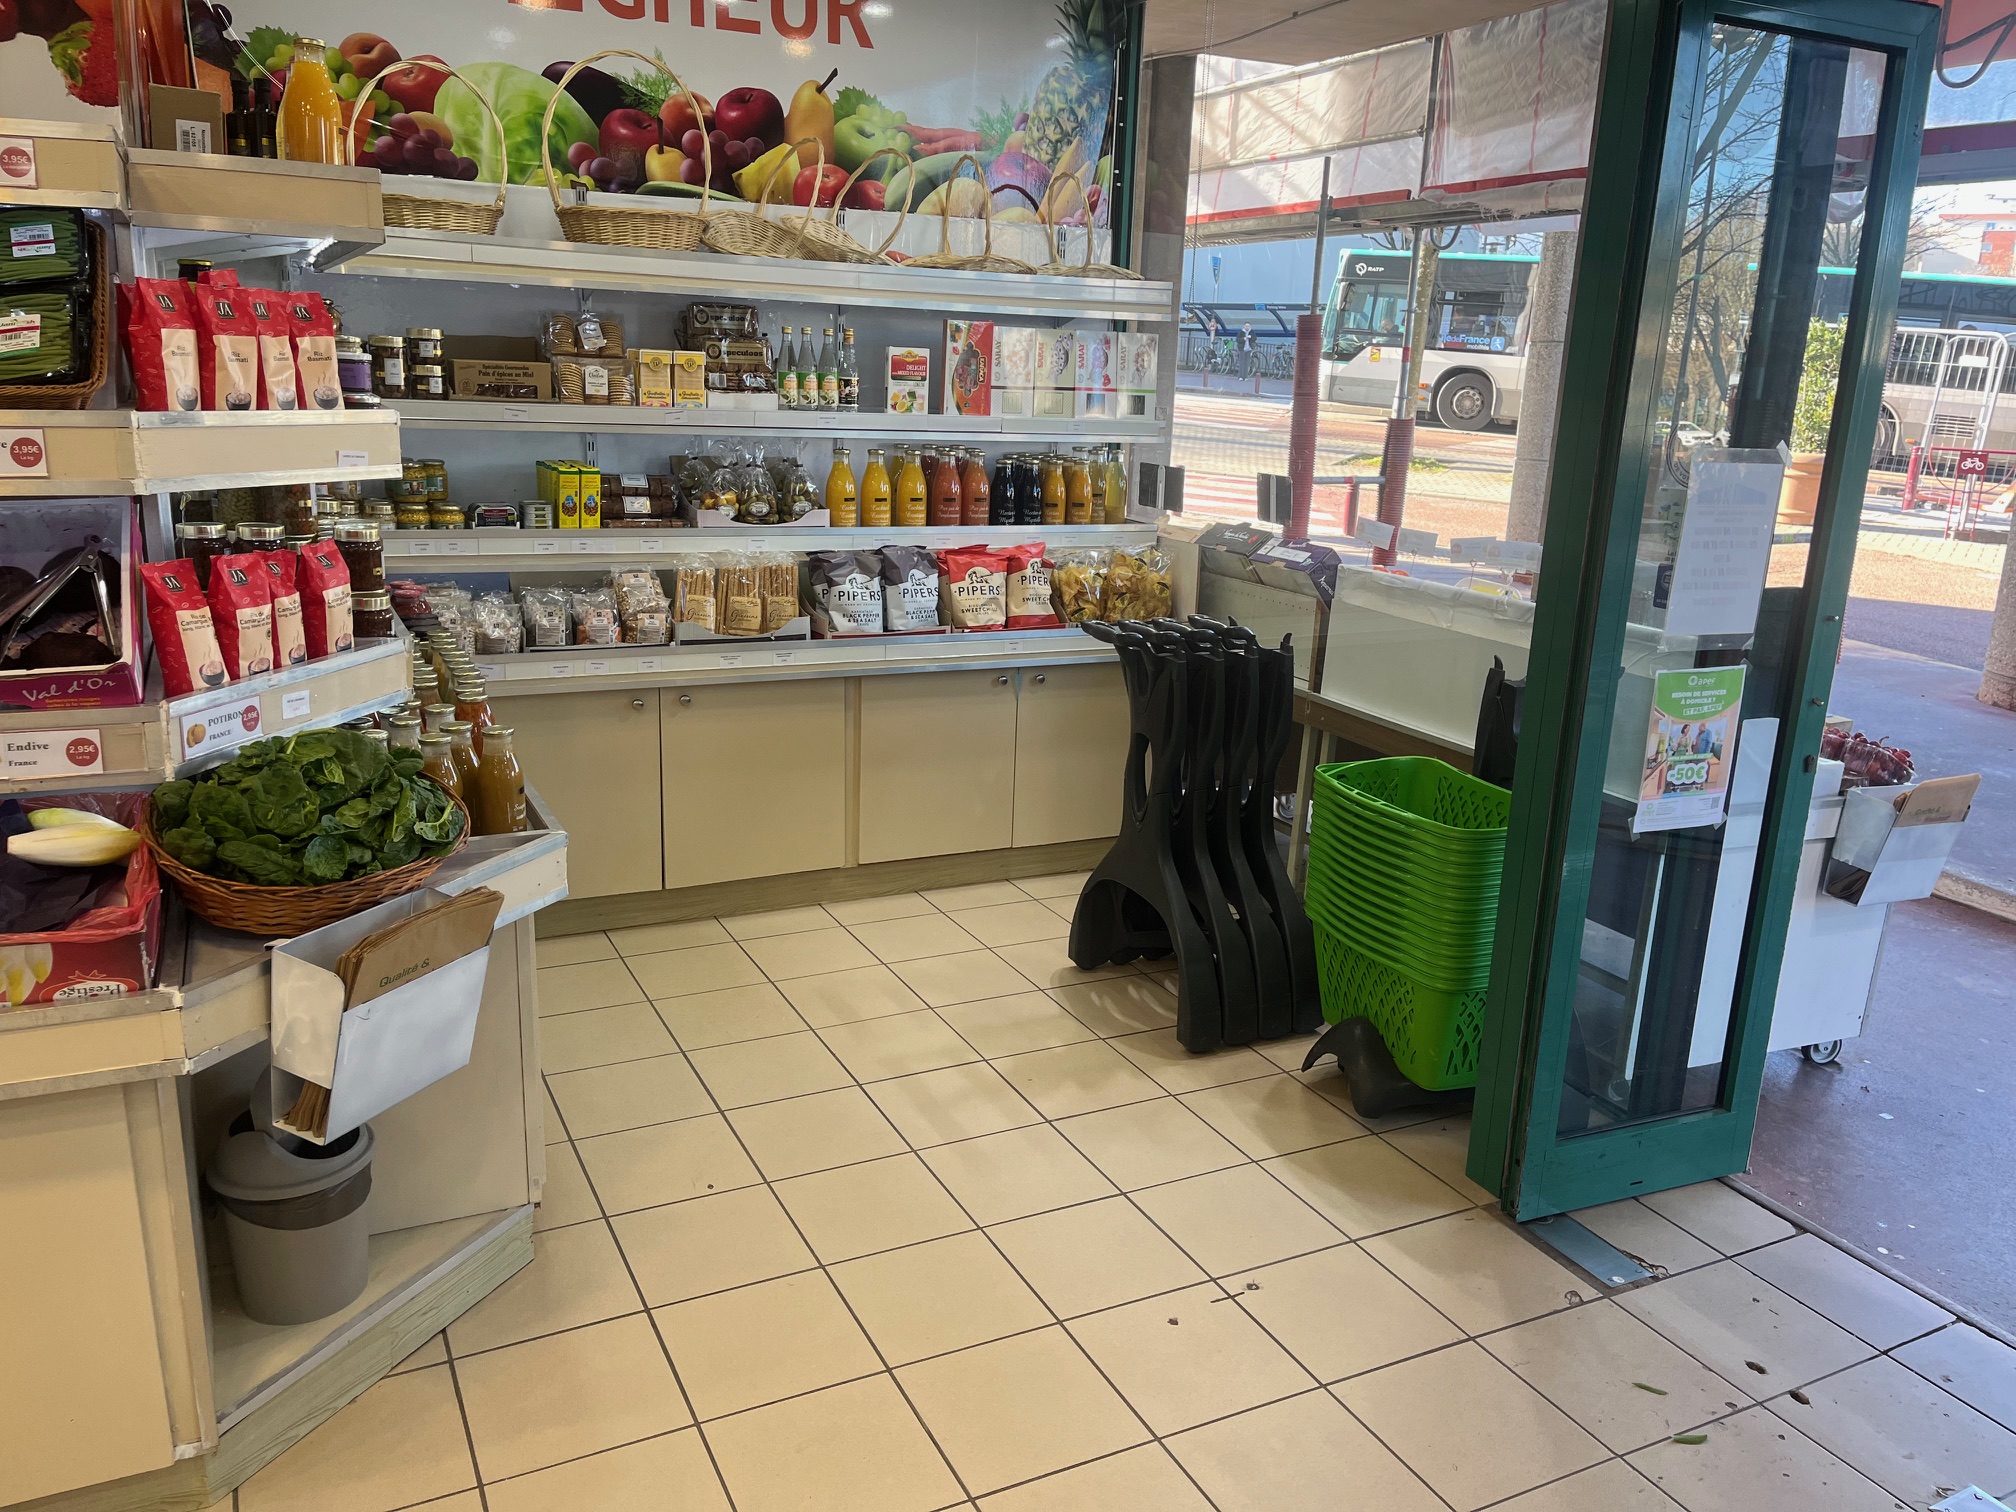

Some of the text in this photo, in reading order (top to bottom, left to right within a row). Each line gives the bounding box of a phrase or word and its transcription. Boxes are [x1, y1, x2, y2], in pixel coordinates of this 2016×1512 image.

[159, 296, 173, 308] JA
[217, 303, 233, 316] JA
[256, 303, 268, 316] JA
[296, 307, 311, 319] JA
[709, 314, 747, 323] speuloo
[994, 340, 1002, 368] SARAY
[1037, 342, 1045, 369] SARAY
[13, 445, 40, 454] 3,95€
[231, 569, 246, 583] JA
[1020, 575, 1050, 587] PIPER
[166, 577, 181, 589] JA
[838, 590, 881, 602] PIPERS
[902, 586, 940, 599] PIPERS
[958, 585, 1001, 597] PIPERS
[181, 618, 209, 627] Camargue
[22, 684, 62, 702] Val
[67, 678, 116, 694] d'Or
[1672, 691, 1693, 699] BESOIN
[1701, 689, 1727, 697] SERVICES
[1686, 697, 1712, 705] DOMICILE
[208, 710, 244, 727] POTIRON
[209, 729, 232, 741] FRANCE
[7, 742, 96, 755] Endive 2,95€
[1670, 766, 1705, 781] -50€
[379, 958, 431, 988] Qualité &
[59, 984, 122, 998] Prestige
